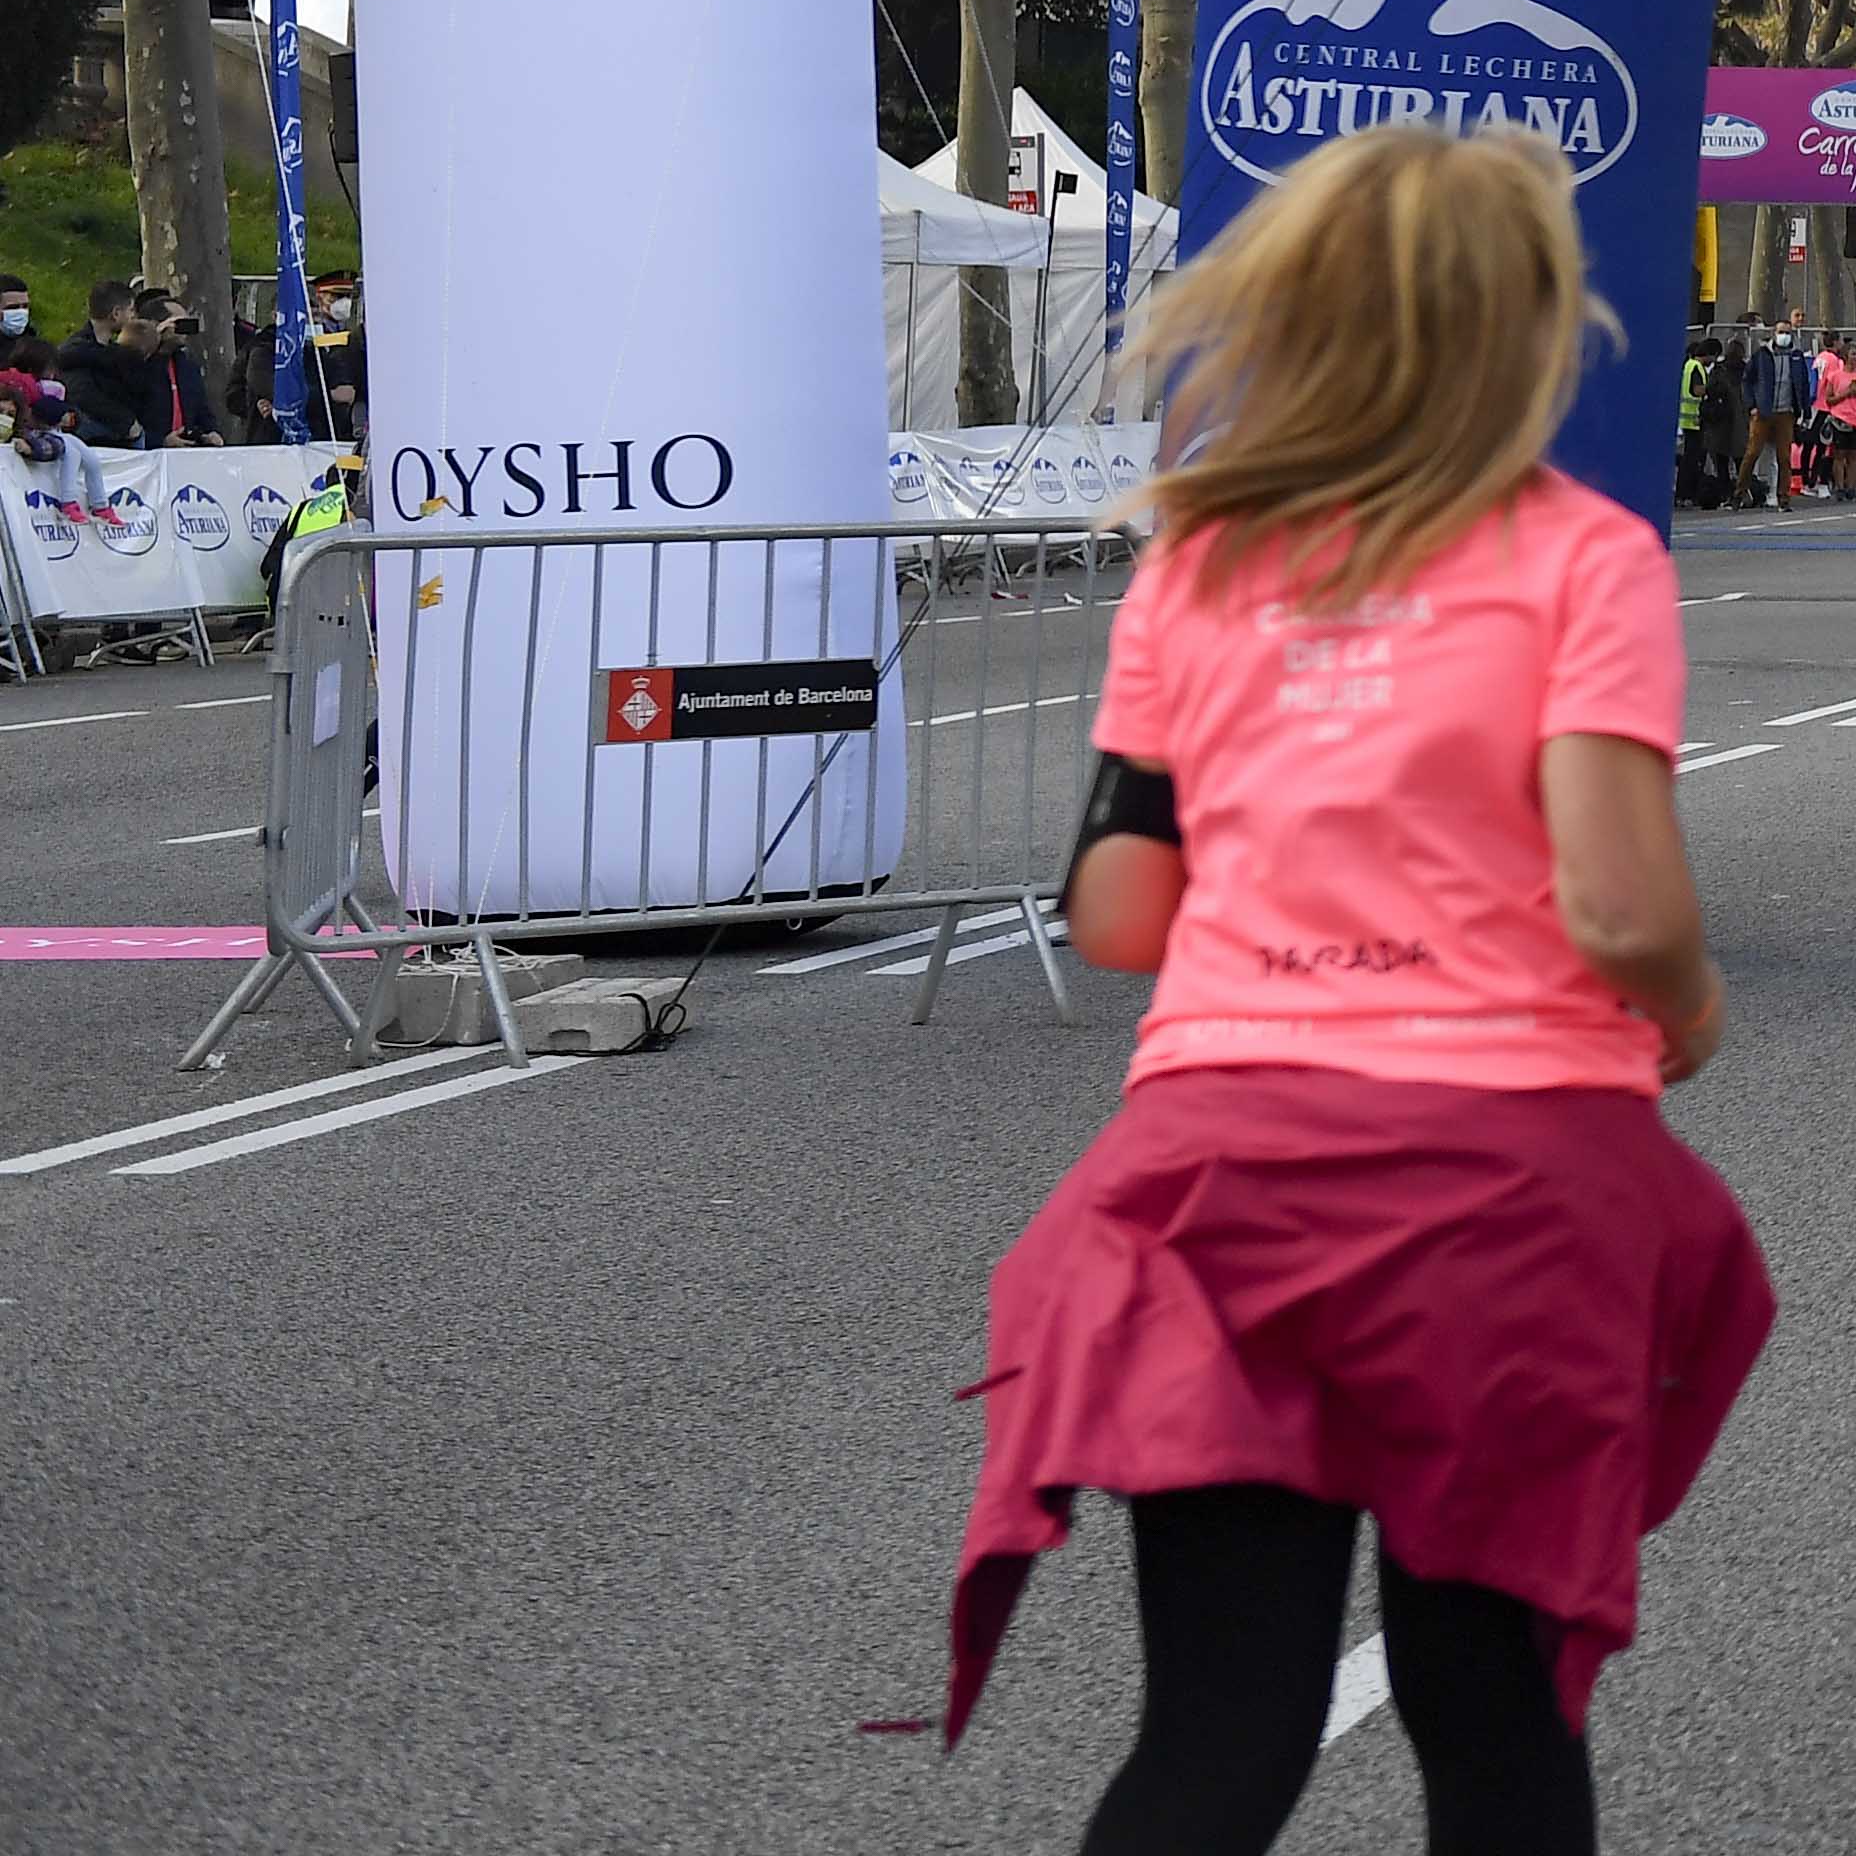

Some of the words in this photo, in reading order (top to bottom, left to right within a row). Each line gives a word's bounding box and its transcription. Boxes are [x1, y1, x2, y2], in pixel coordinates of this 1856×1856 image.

[1274, 42, 1422, 72] CENTRAL
[1440, 53, 1599, 84] LECHERA
[1701, 135, 1760, 148] TURIANA
[1819, 157, 1838, 175] de
[1841, 155, 1854, 176] la
[392, 434, 733, 522] OYSHO
[678, 691, 770, 712] Ajuntament
[774, 690, 793, 705] de
[799, 686, 873, 705] Barcelona
